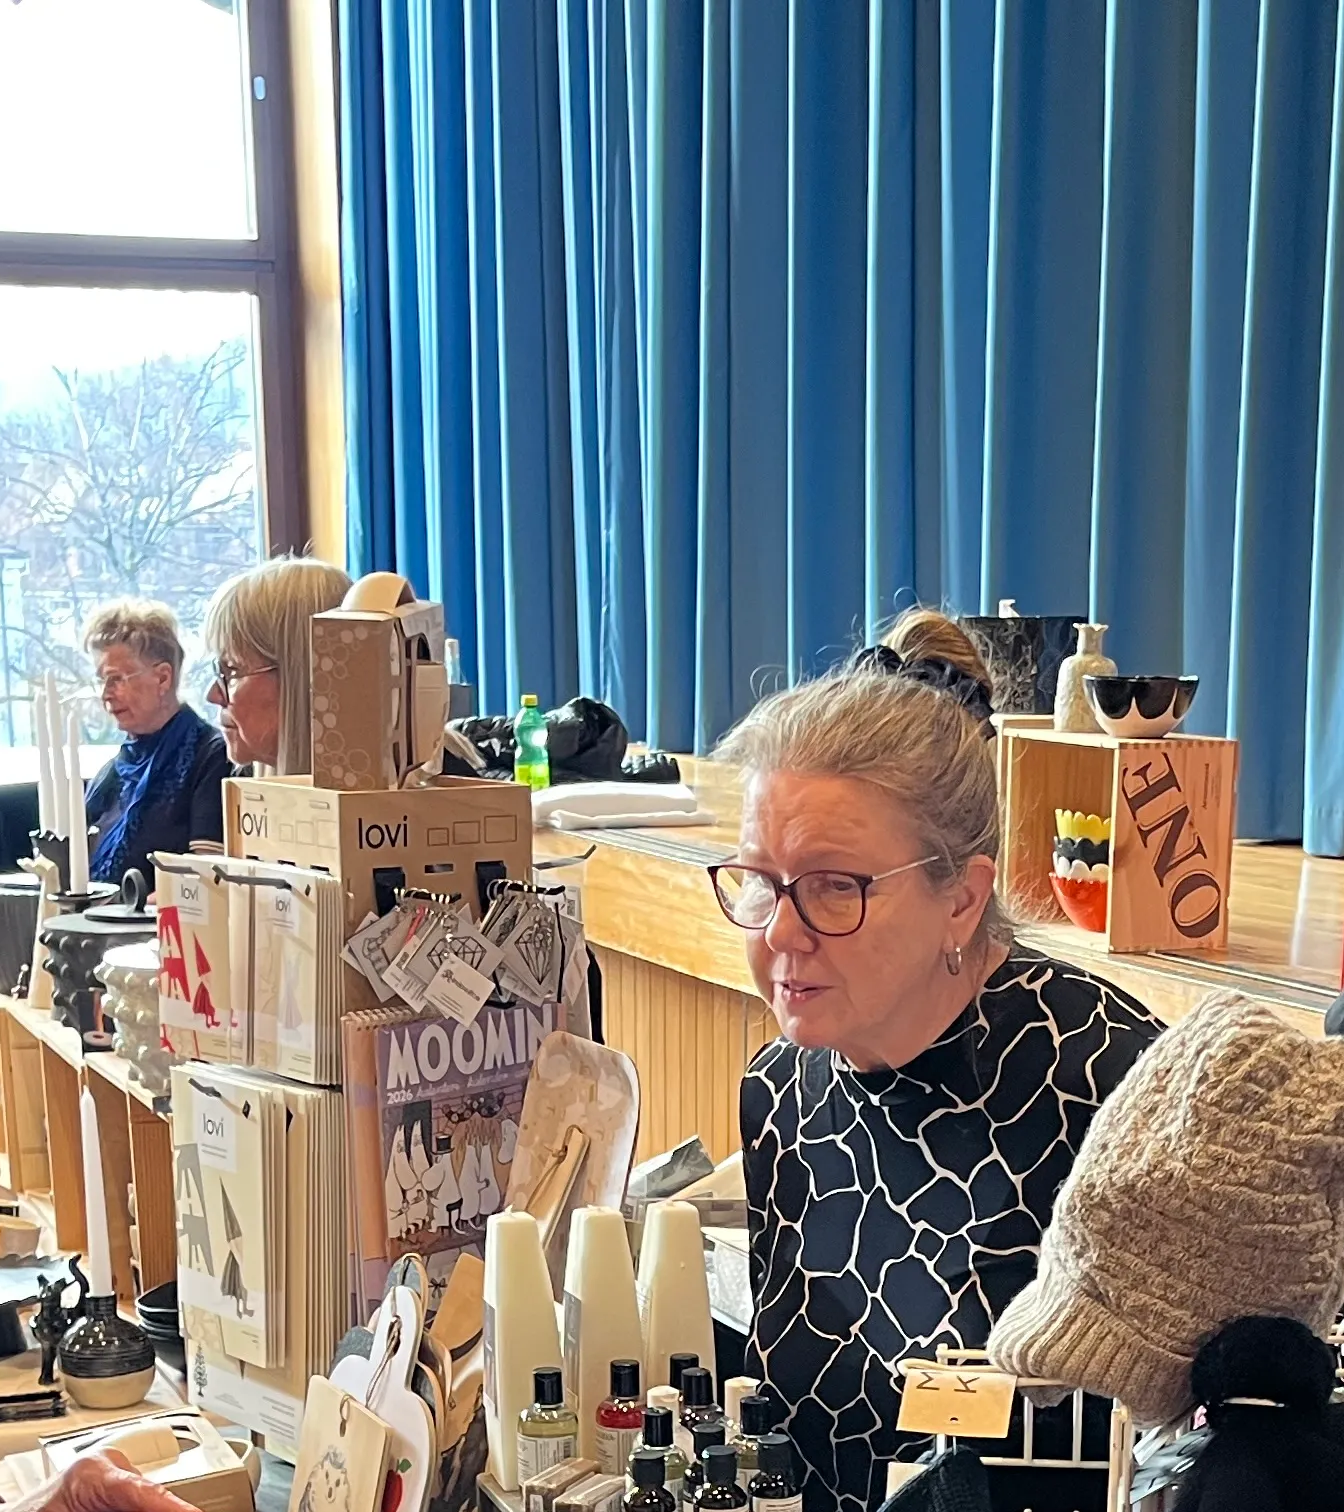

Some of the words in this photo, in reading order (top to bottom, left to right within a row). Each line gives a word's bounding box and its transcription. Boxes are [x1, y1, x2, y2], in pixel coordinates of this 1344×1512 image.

[236, 803, 268, 839] lovi
[357, 815, 408, 850] lovi
[1121, 752, 1222, 939] ONE
[180, 883, 199, 902] lovi
[386, 1003, 553, 1090] MOOMIN
[386, 1089, 414, 1105] 2026
[202, 1112, 224, 1138] lovi
